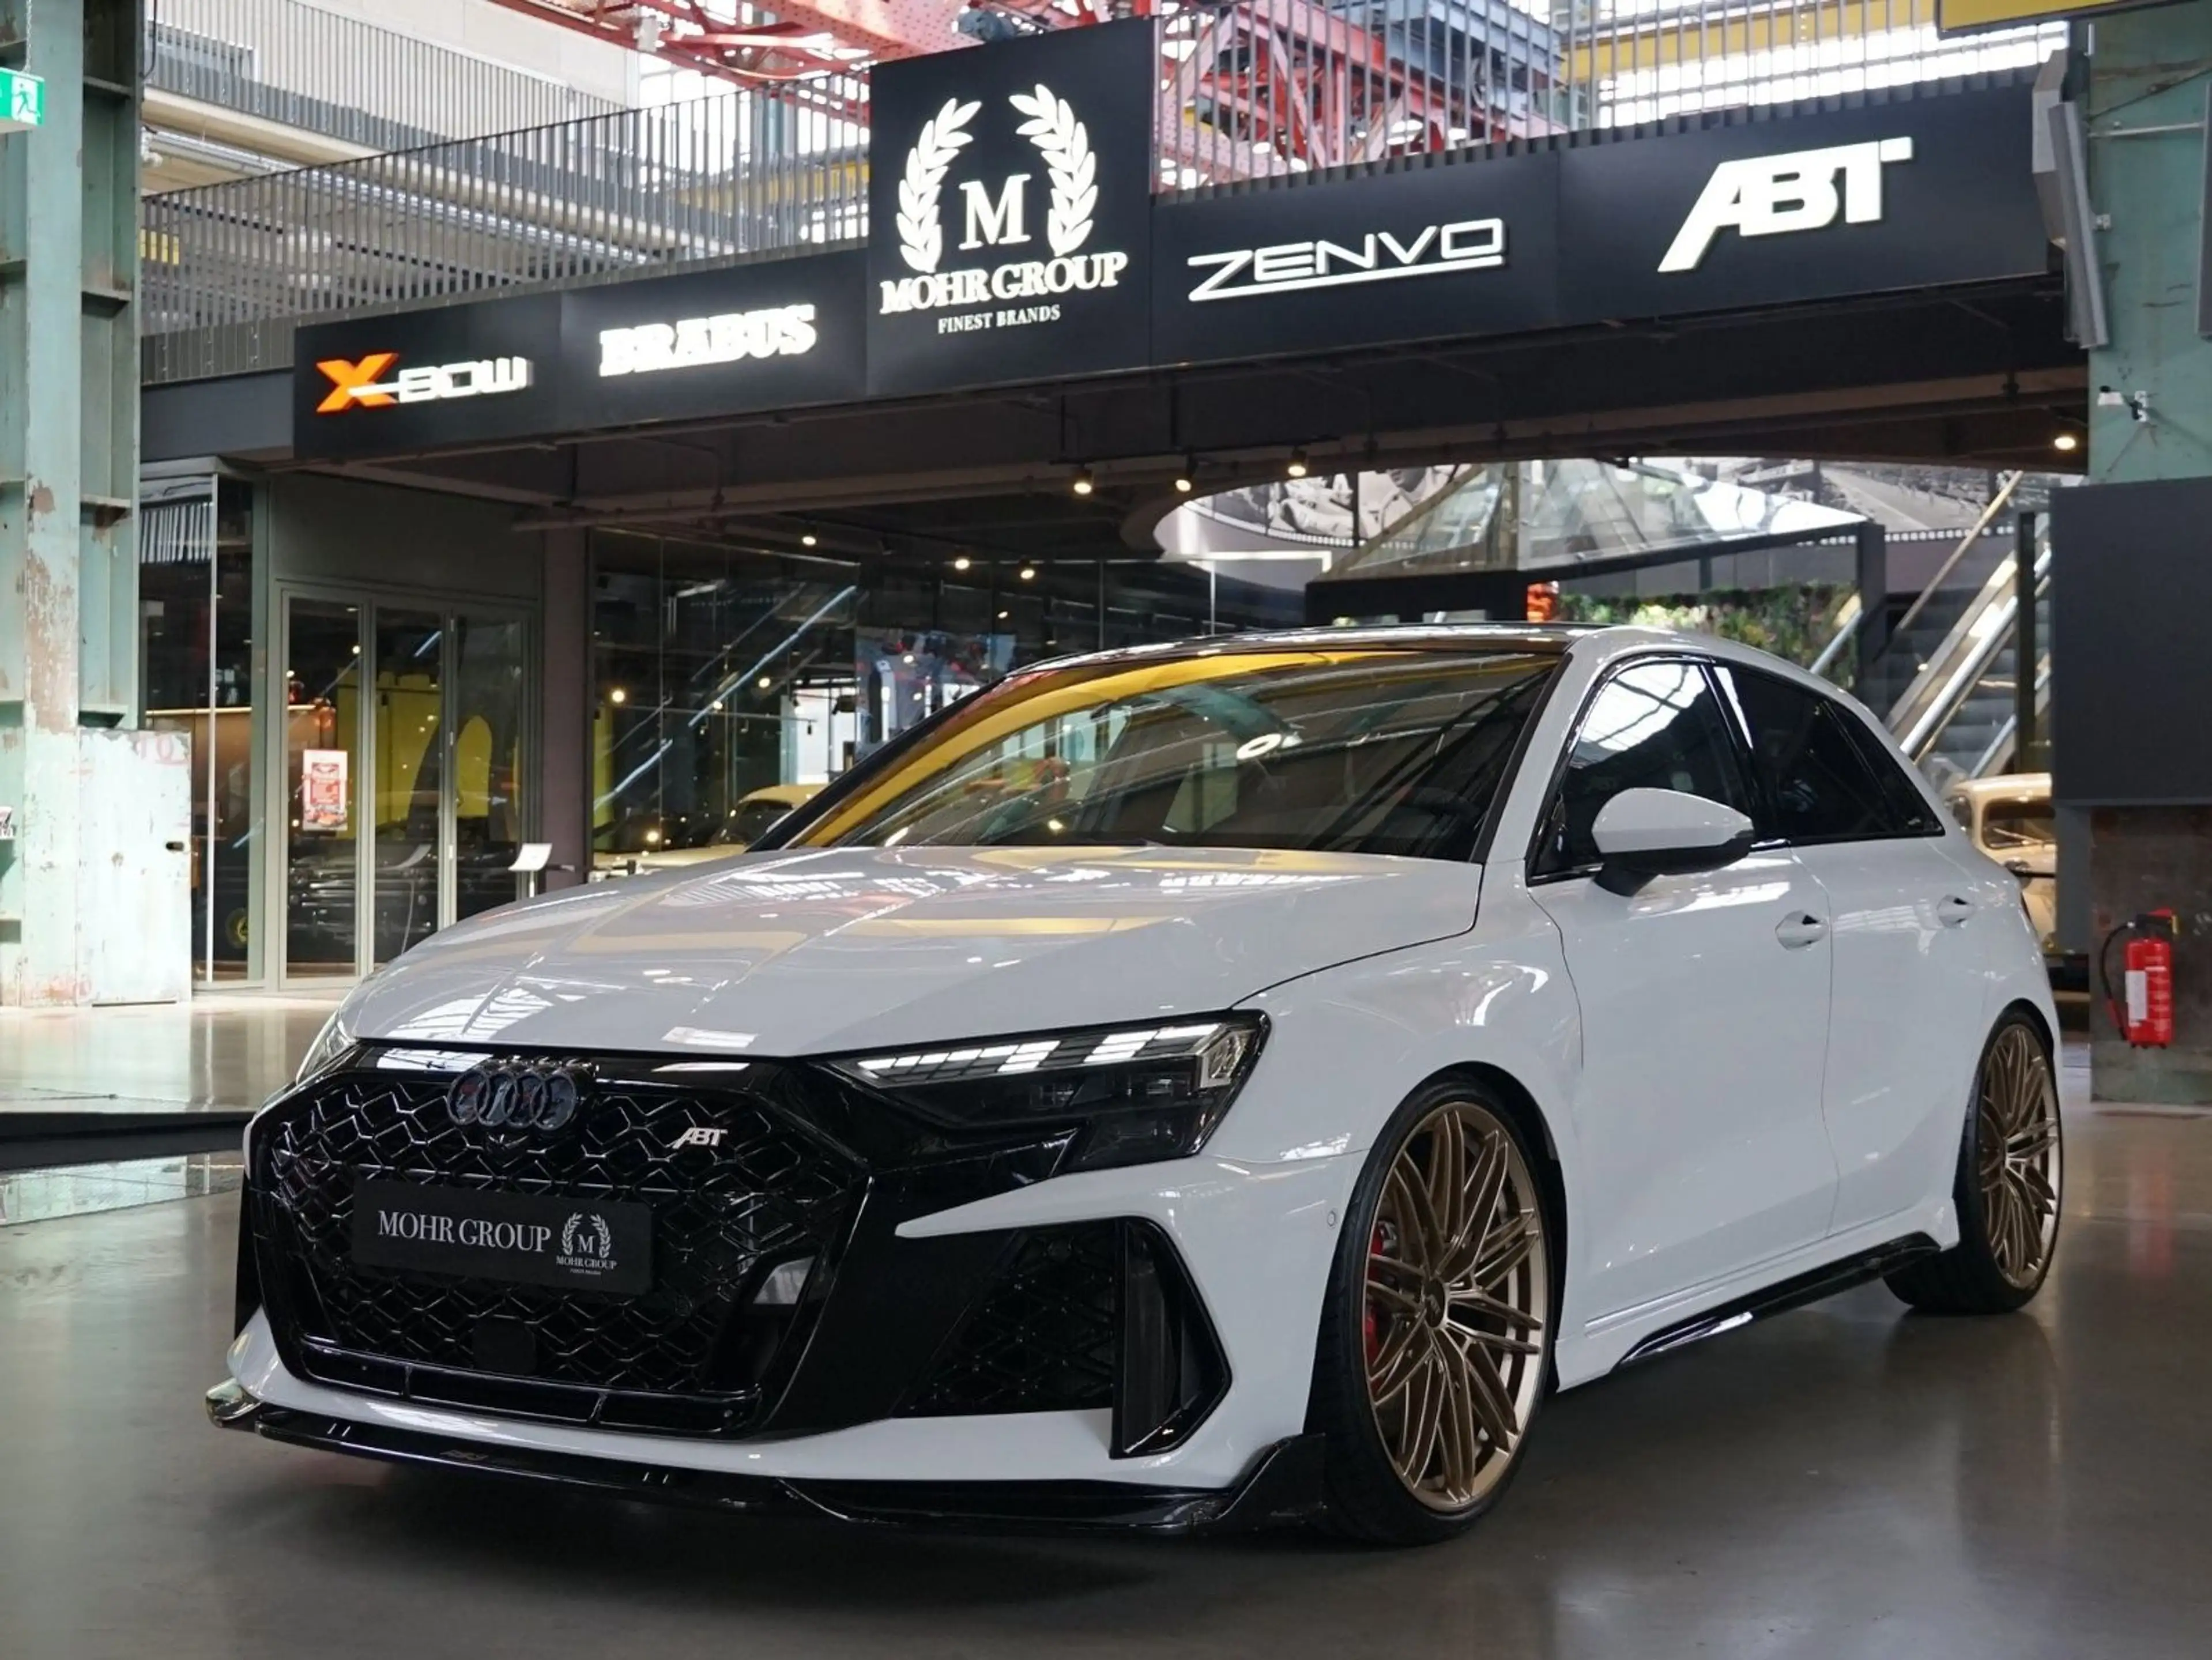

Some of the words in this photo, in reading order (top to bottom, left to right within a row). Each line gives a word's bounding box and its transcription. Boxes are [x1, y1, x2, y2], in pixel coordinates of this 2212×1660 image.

[958, 174, 1031, 250] M
[1657, 136, 1913, 273] ABT
[879, 268, 992, 314] MOHR
[991, 251, 1129, 300] GROUP
[1187, 218, 1503, 301] ZENVO
[600, 304, 816, 376] BRABUS
[937, 313, 993, 334] FINEST
[996, 304, 1061, 327] BRANDS
[672, 1127, 728, 1149] ABT
[378, 1210, 455, 1243] MOHR
[458, 1218, 552, 1252] GROUP
[577, 1234, 596, 1253] M
[556, 1255, 584, 1267] MOHR
[584, 1258, 617, 1270] GROUP
